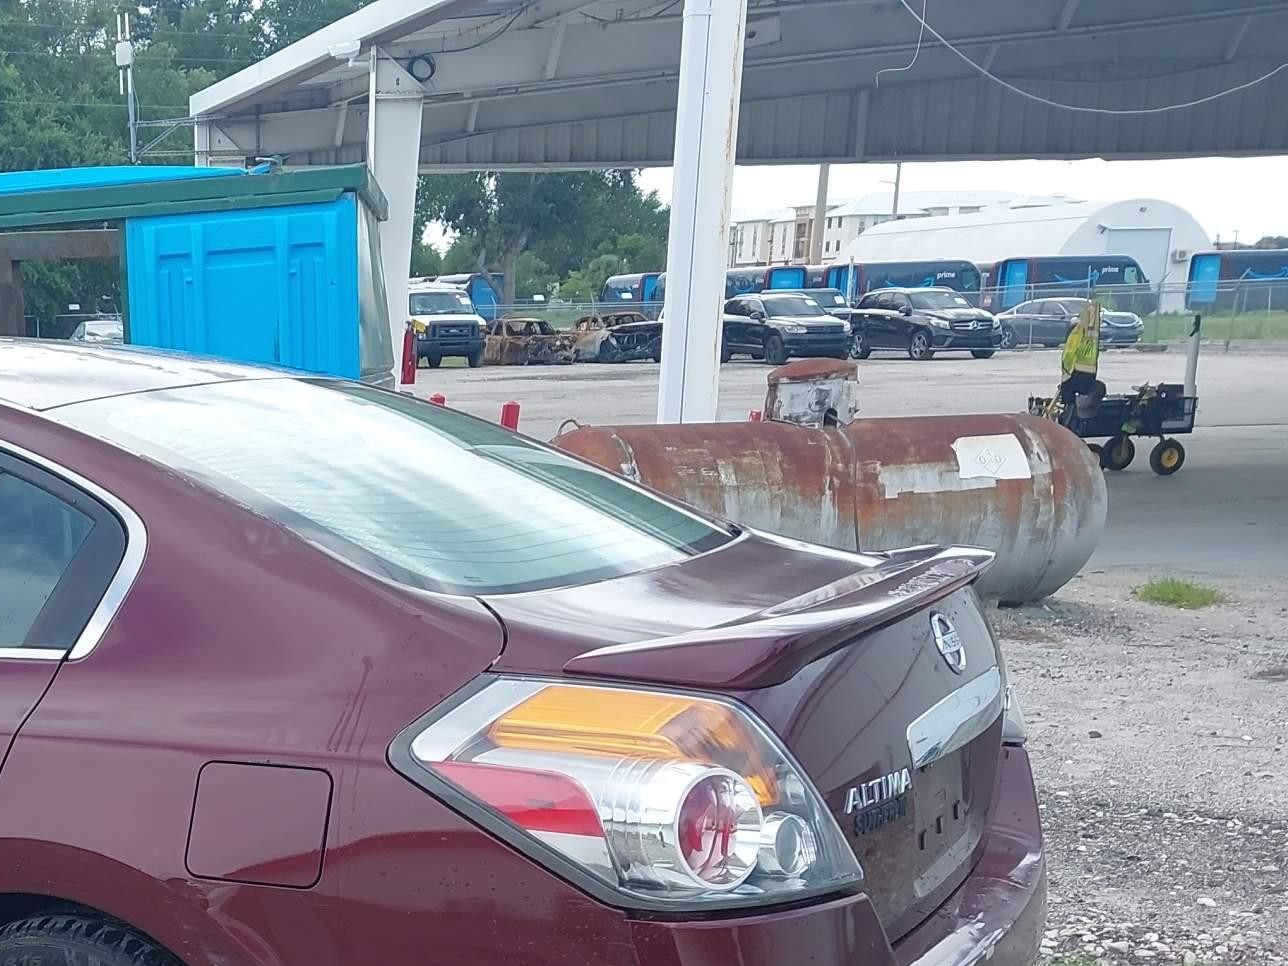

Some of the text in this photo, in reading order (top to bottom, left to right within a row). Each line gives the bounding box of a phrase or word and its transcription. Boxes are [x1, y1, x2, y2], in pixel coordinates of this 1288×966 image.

[1102, 265, 1119, 274] prime
[937, 271, 956, 280] prime
[843, 768, 912, 815] ALTIMA
